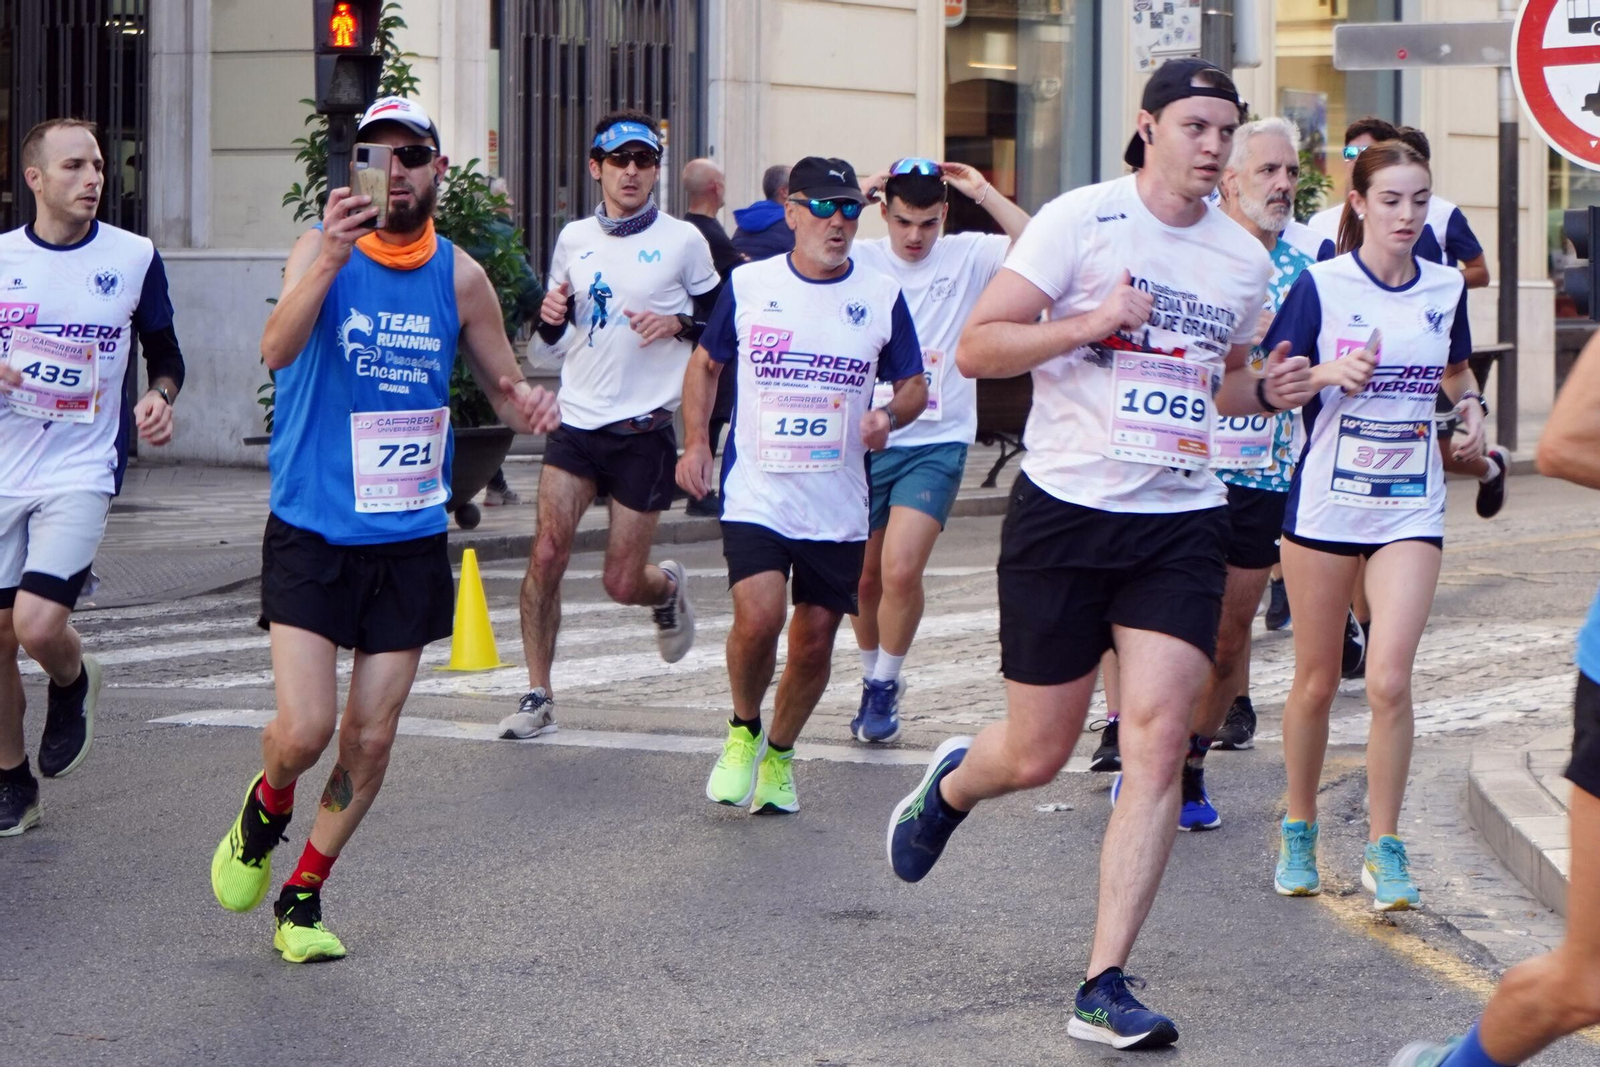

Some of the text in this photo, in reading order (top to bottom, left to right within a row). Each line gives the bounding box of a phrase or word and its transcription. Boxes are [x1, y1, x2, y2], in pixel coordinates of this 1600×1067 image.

[1150, 280, 1199, 301] TotalEnergies
[377, 312, 430, 334] TEAM
[32, 337, 84, 355] CARRERA
[376, 332, 441, 352] RUNNING
[356, 355, 429, 385] Encarnita
[750, 350, 872, 374] CARRERA
[22, 361, 83, 388] 435
[755, 365, 866, 387] UNIVERSIDAD
[378, 382, 410, 395] GRANADA
[777, 395, 828, 403] CARRERA
[1121, 388, 1206, 422] 1069
[377, 416, 434, 427] CARRERA
[774, 417, 828, 437] 136
[1360, 421, 1415, 432] CARRERA
[377, 442, 432, 468] 721
[1352, 445, 1414, 470] 377
